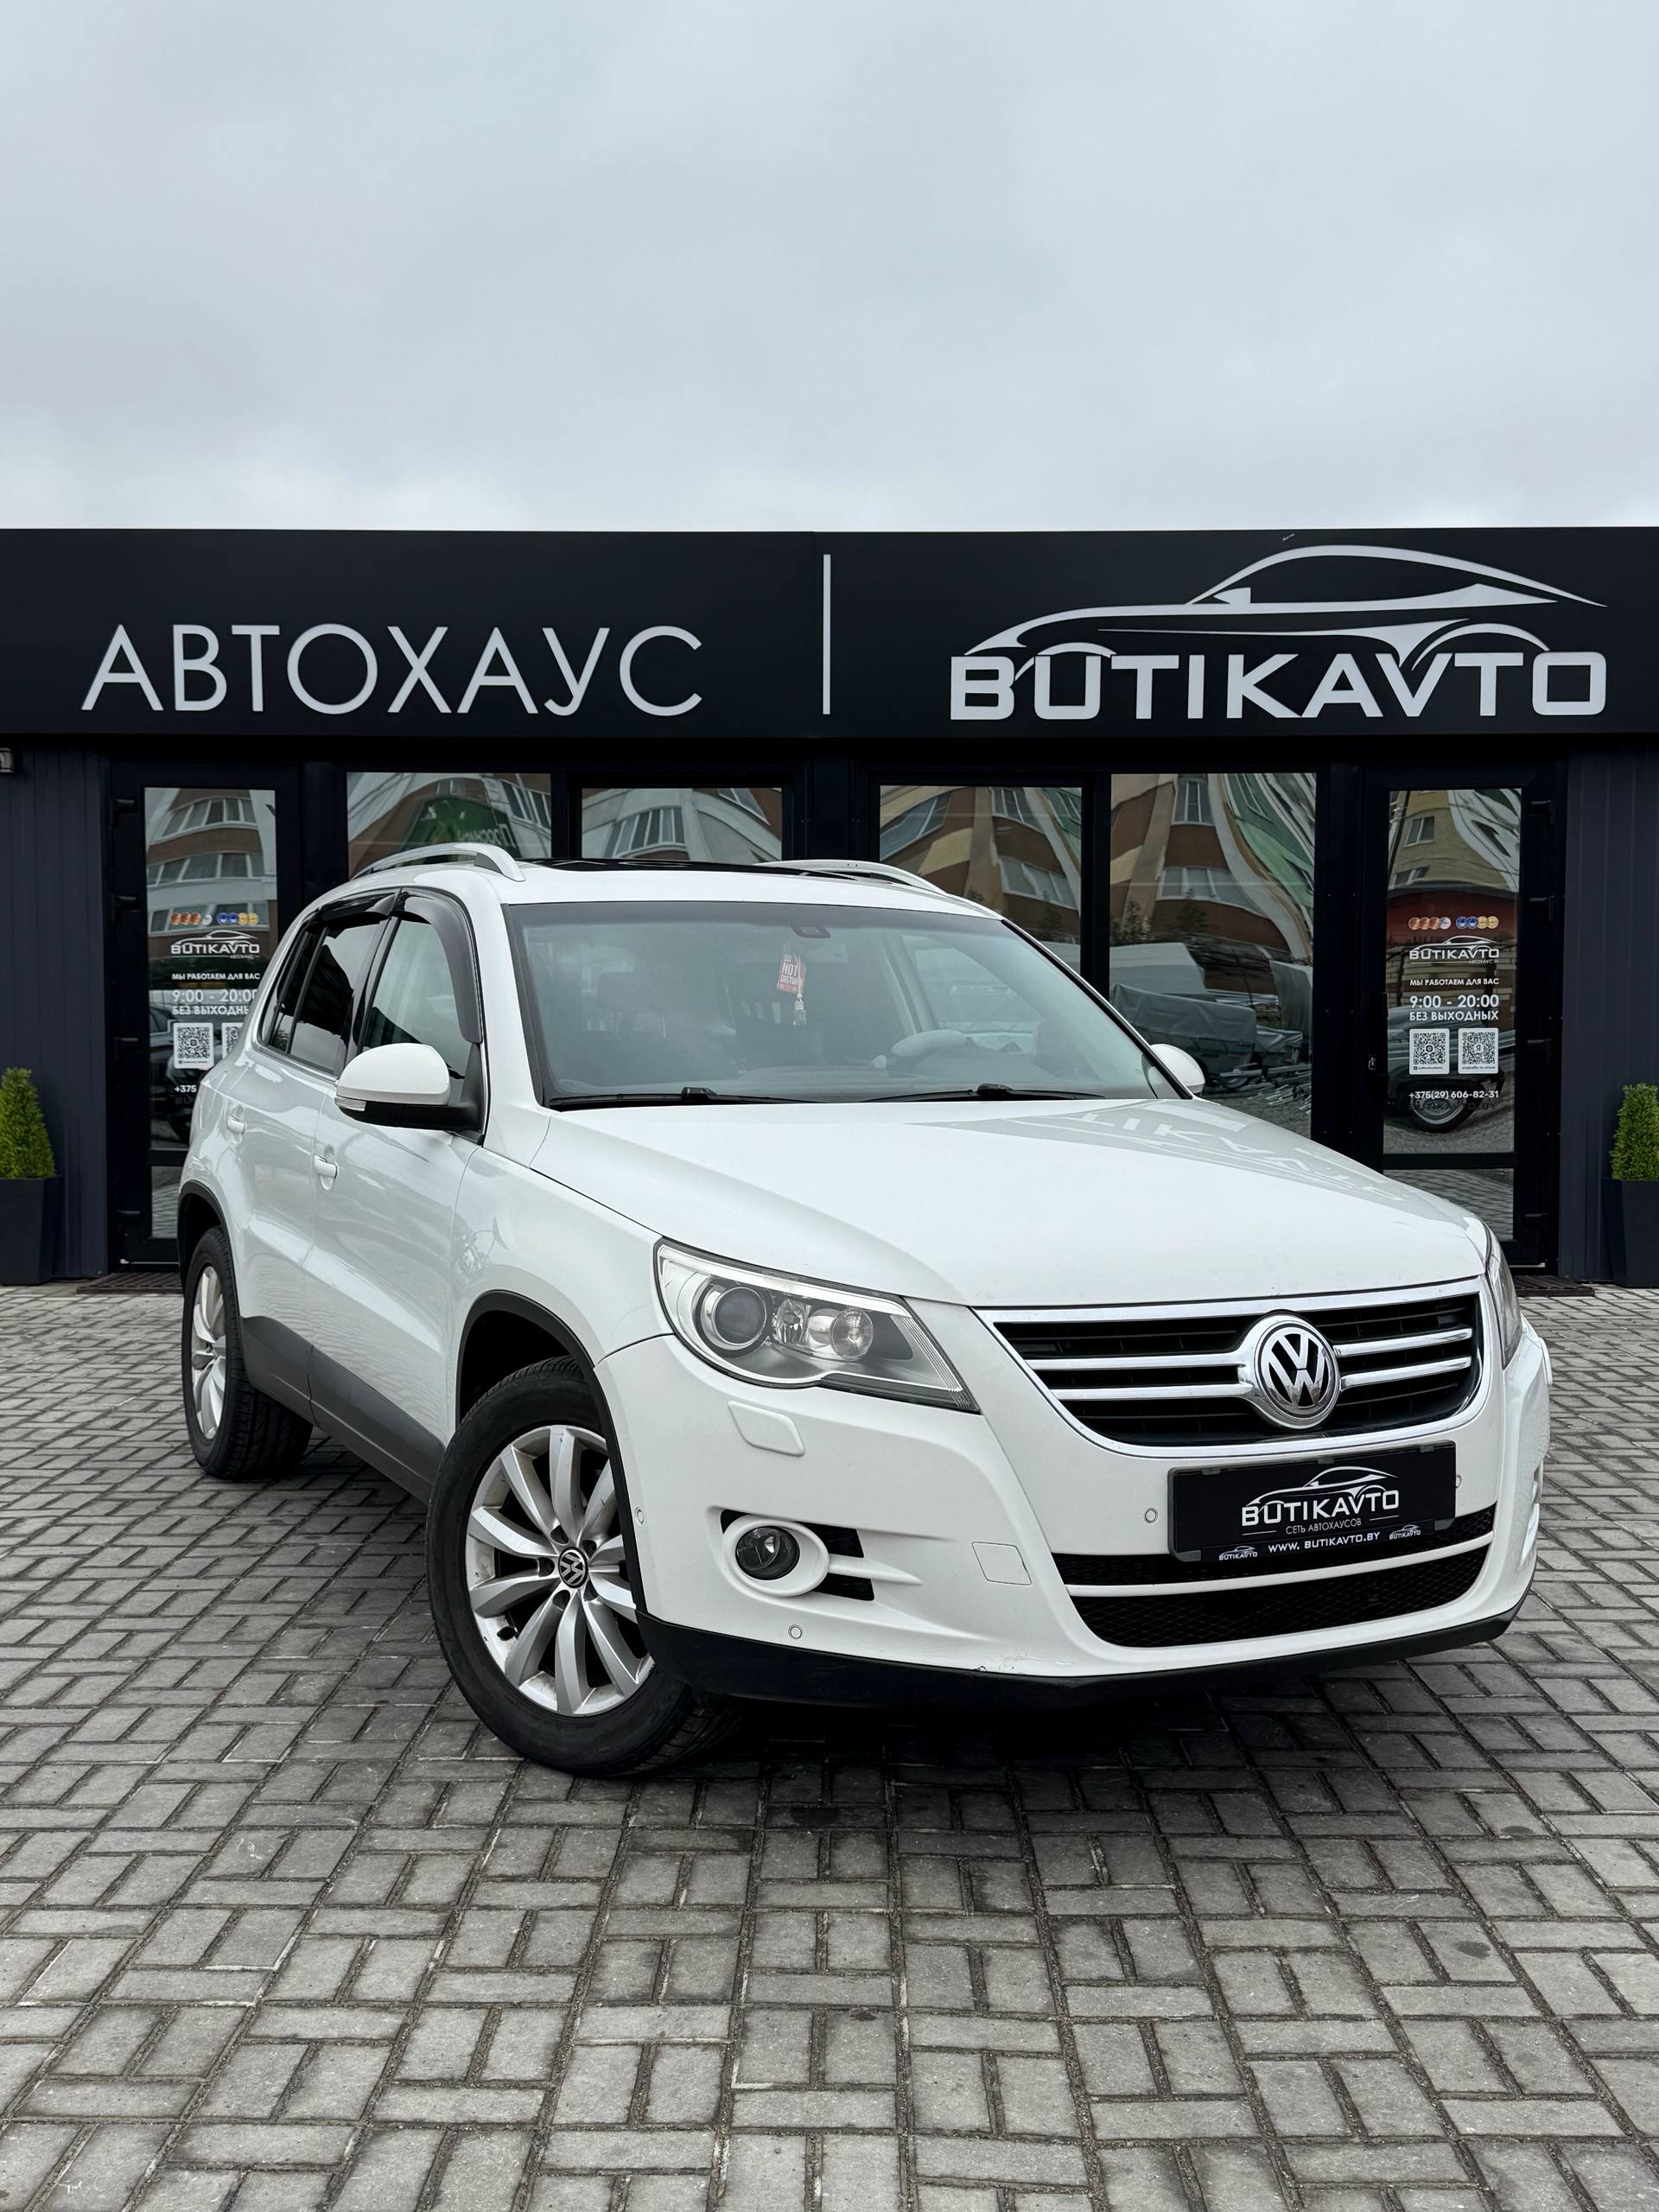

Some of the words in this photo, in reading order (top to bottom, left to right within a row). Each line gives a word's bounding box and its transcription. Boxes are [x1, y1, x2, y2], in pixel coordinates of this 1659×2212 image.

[81, 623, 702, 716] АВТОХАУС
[950, 651, 1607, 721] BUTIKAVTO
[171, 944, 260, 955] BUTIKAVTO
[1409, 949, 1499, 960] BUTIKAVTO
[781, 963, 798, 976] NOT
[173, 988, 204, 1002] 9:00
[1409, 995, 1441, 1008] 9:00
[1458, 994, 1499, 1007] 20:00
[173, 1005, 191, 1015] БЕЗ
[194, 1005, 249, 1015] ВЫХОДН
[1409, 1011, 1427, 1021] БЕЗ
[1431, 1010, 1499, 1021] ВЫХОДНЫХ
[174, 1084, 197, 1093] +375
[1408, 1090, 1449, 1099] +375(29)
[1451, 1090, 1499, 1099] 606-82-31
[1241, 1489, 1400, 1527] BUTIKAVTO
[1285, 1525, 1306, 1535] СЕТЬ
[1307, 1517, 1362, 1533] АВТОХАУСОВ
[1304, 1531, 1381, 1549] BUTIKAVTO.BY
[1389, 1529, 1421, 1540] BUTIKAVTO
[1218, 1551, 1258, 1560] BUTIKAVTO
